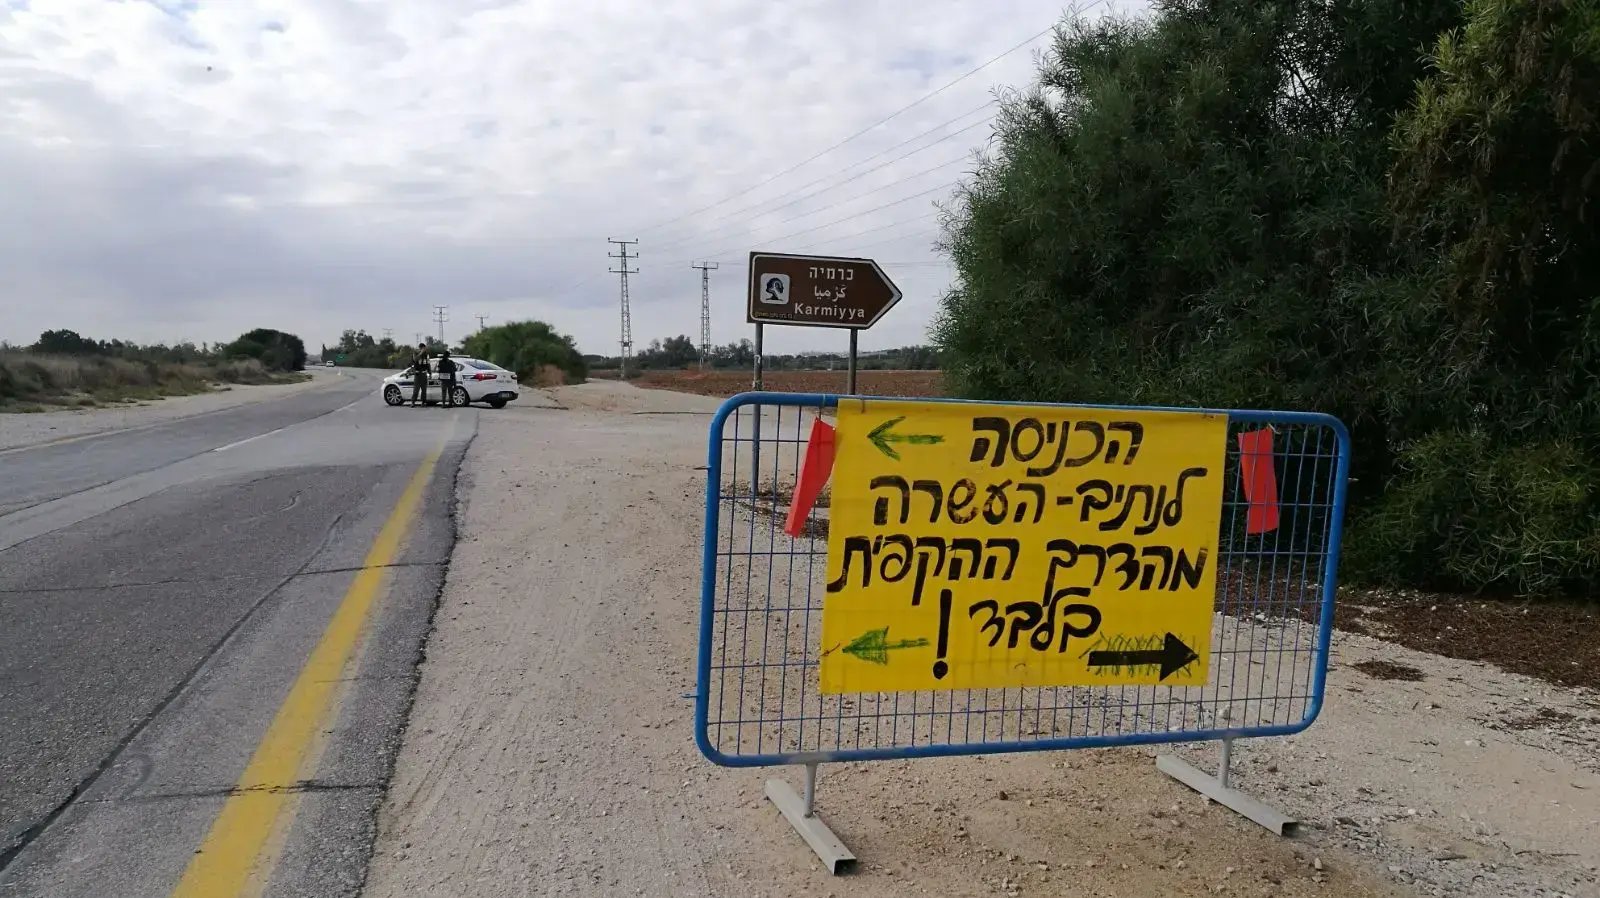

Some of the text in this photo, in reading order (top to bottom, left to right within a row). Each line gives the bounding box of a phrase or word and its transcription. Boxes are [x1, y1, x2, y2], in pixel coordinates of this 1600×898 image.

[809, 267, 854, 281] כרמיה
[794, 302, 865, 320] Karmiyya
[971, 416, 1143, 478] הכניסה
[1045, 538, 1208, 607] מהדרך
